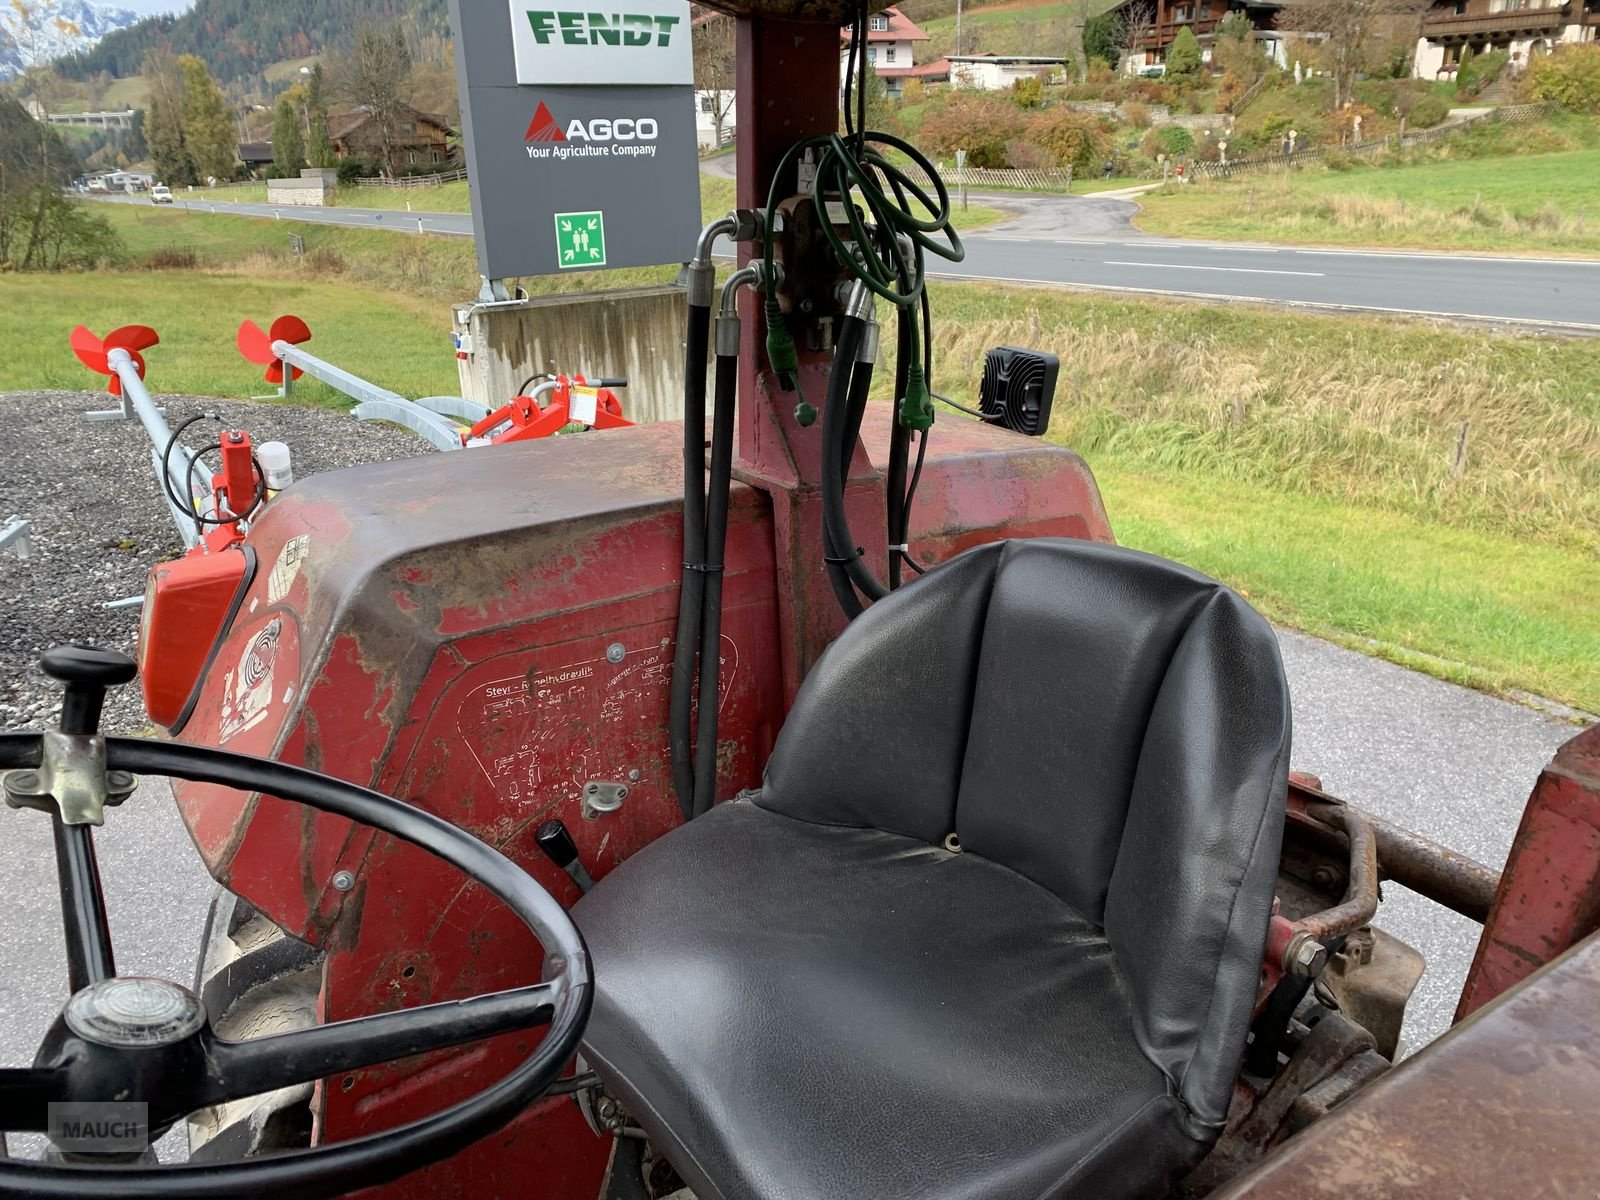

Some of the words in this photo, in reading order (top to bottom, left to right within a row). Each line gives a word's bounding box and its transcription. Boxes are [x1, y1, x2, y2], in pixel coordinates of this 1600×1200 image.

[526, 10, 680, 47] FENDT
[565, 118, 658, 141] AGCO
[526, 145, 551, 158] Your
[552, 144, 609, 160] Agriculture
[611, 143, 657, 157] Company
